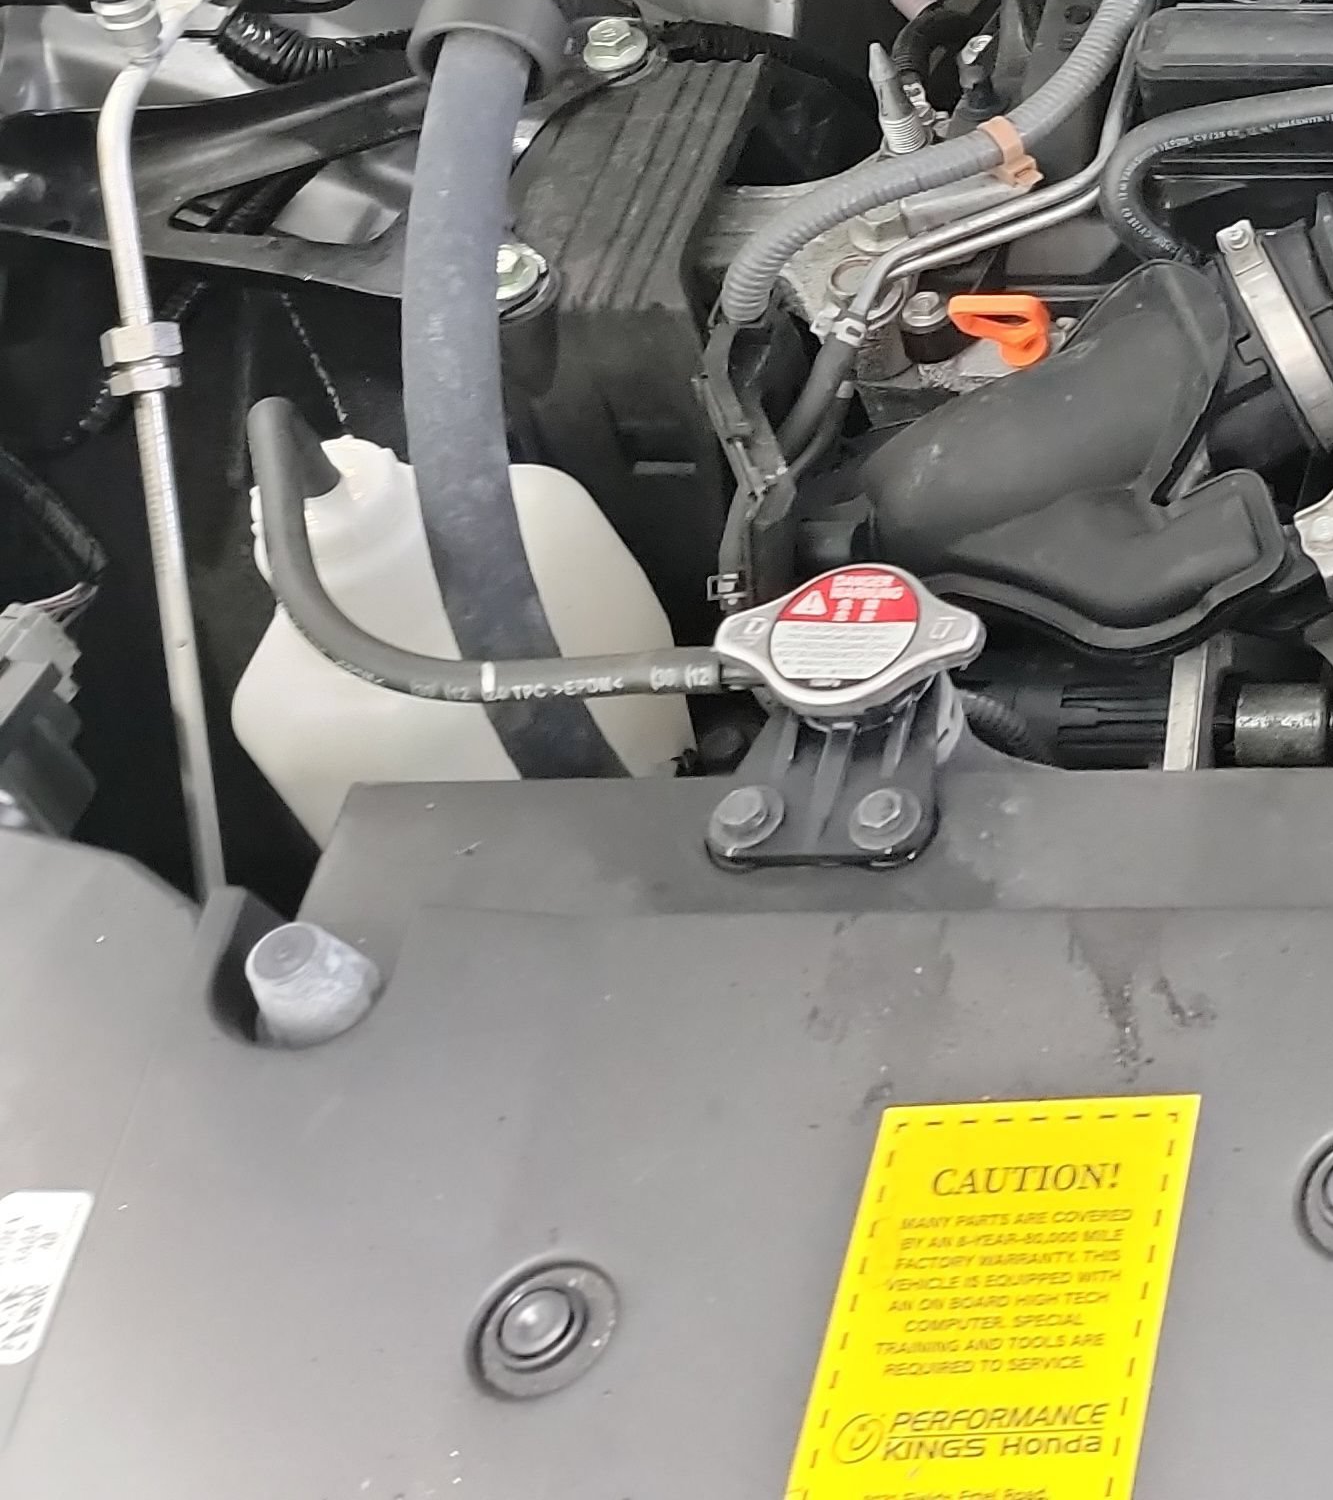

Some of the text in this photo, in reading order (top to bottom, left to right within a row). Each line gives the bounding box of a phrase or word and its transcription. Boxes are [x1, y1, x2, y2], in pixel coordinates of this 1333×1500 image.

[933, 1163, 1120, 1196] CAUTION!
[955, 1214, 1010, 1227] PARTS
[1013, 1212, 1049, 1225] ARE
[1052, 1209, 1133, 1223] COVERED
[900, 1238, 921, 1250] BY
[928, 1236, 952, 1248] AN
[1081, 1229, 1125, 1242] MILE
[894, 1255, 975, 1270] FACTORY
[1083, 1250, 1121, 1262] THIS
[886, 1270, 1121, 1291] VEHICLE IS EQUIPPED WITH
[917, 1297, 943, 1311] ON
[949, 1295, 1010, 1309] BOARD
[1015, 1294, 1059, 1307] HIGH
[1064, 1292, 1110, 1304] TECH
[1011, 1314, 1084, 1328] SPECIAL
[875, 1334, 1105, 1355] TRAINING AND TOOLS ARE
[883, 1360, 974, 1376] REQUIRED
[980, 1359, 1003, 1372] TO
[890, 1402, 1110, 1433] PERFORMANCE
[882, 1436, 1103, 1460] KINGS Honda
